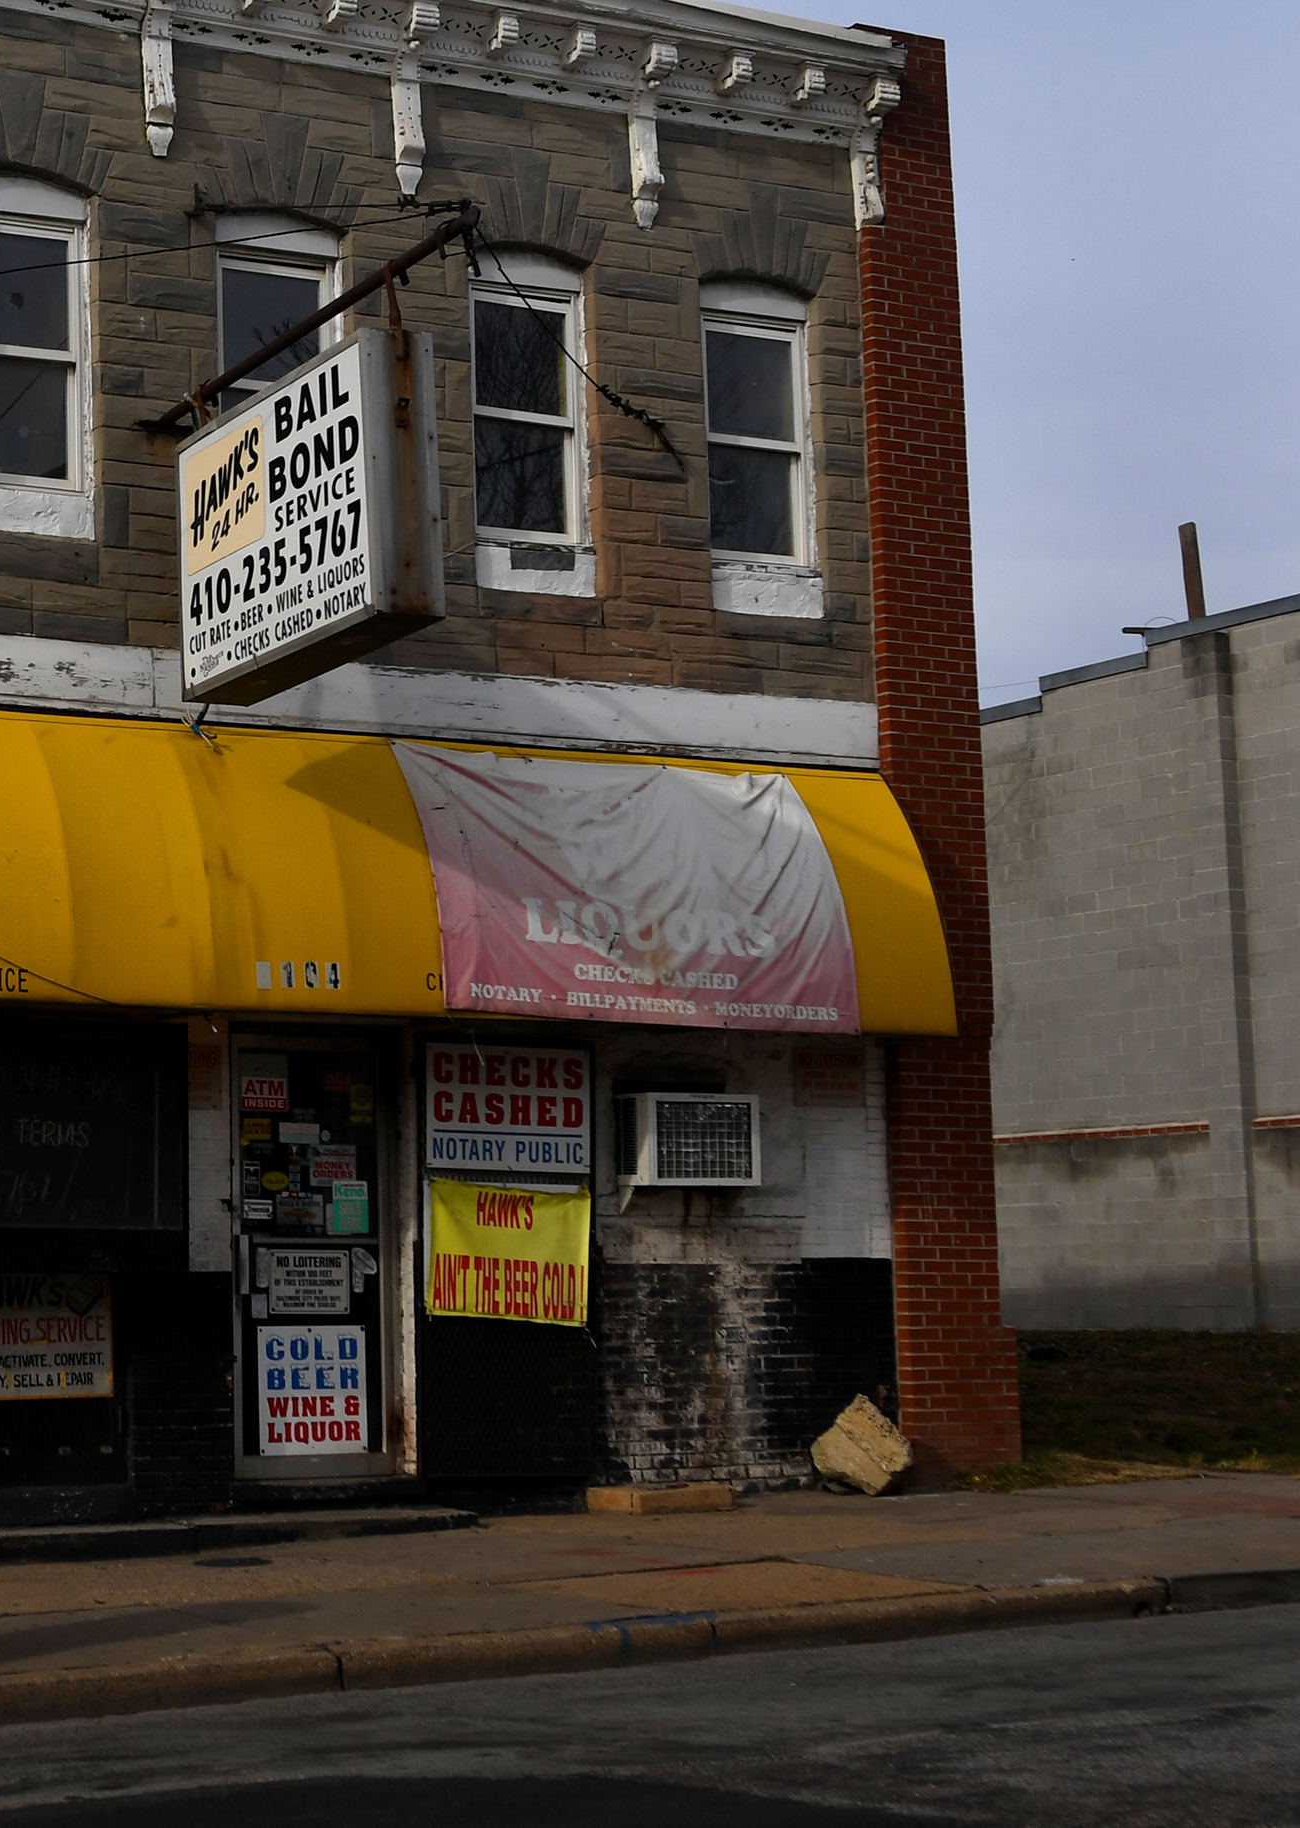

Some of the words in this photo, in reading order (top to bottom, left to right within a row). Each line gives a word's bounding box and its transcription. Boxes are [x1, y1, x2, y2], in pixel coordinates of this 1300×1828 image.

[274, 363, 350, 444] BAIL
[268, 415, 360, 504] BOND
[190, 426, 260, 548] HAWK'S
[274, 466, 356, 533] SERVICE
[211, 516, 232, 552] 24
[234, 482, 260, 525] HR.
[190, 499, 362, 627] 410-235-5767
[189, 631, 207, 655] CUT
[210, 619, 232, 647] RATE
[240, 604, 263, 631] BEER
[275, 584, 303, 613] WINE
[306, 579, 315, 599] &
[317, 554, 366, 594] LIQUORS
[234, 628, 271, 661] CHECKS
[274, 608, 314, 642] CASHED
[323, 582, 367, 620] NOTARY
[521, 897, 778, 959] LIQUORS
[573, 964, 656, 986] CHECKS
[659, 968, 739, 991] CASHED
[470, 983, 542, 1003] NOTARY
[566, 991, 696, 1014] BILLPAYMENTS
[714, 1001, 839, 1021] MONEYORDERS
[433, 1051, 584, 1090] CHECKS
[244, 1080, 285, 1096] ATM
[244, 1098, 285, 1109] INSIDE
[433, 1091, 584, 1128] CASHED
[16, 1116, 90, 1148] TERMS
[315, 1161, 351, 1170] MONEY
[433, 1137, 506, 1161] NOTARY
[516, 1140, 584, 1165] PUBLIC
[313, 1170, 353, 1179] ORDERS
[334, 1184, 365, 1197] Keno
[476, 1191, 535, 1230] HAWK'S
[276, 1256, 289, 1268] NO
[293, 1256, 342, 1268] LOITERING
[433, 1253, 470, 1311] AIN'T
[474, 1256, 500, 1314] THE
[504, 1259, 538, 1317] BEER
[35, 1315, 106, 1344] SERVICE
[266, 1334, 358, 1360] COLD
[13, 1374, 44, 1388] SELL
[46, 1373, 54, 1386] &
[267, 1363, 359, 1390] BEER
[267, 1396, 335, 1417] WINE
[344, 1395, 360, 1415] &
[268, 1421, 361, 1444] LIQUOR
